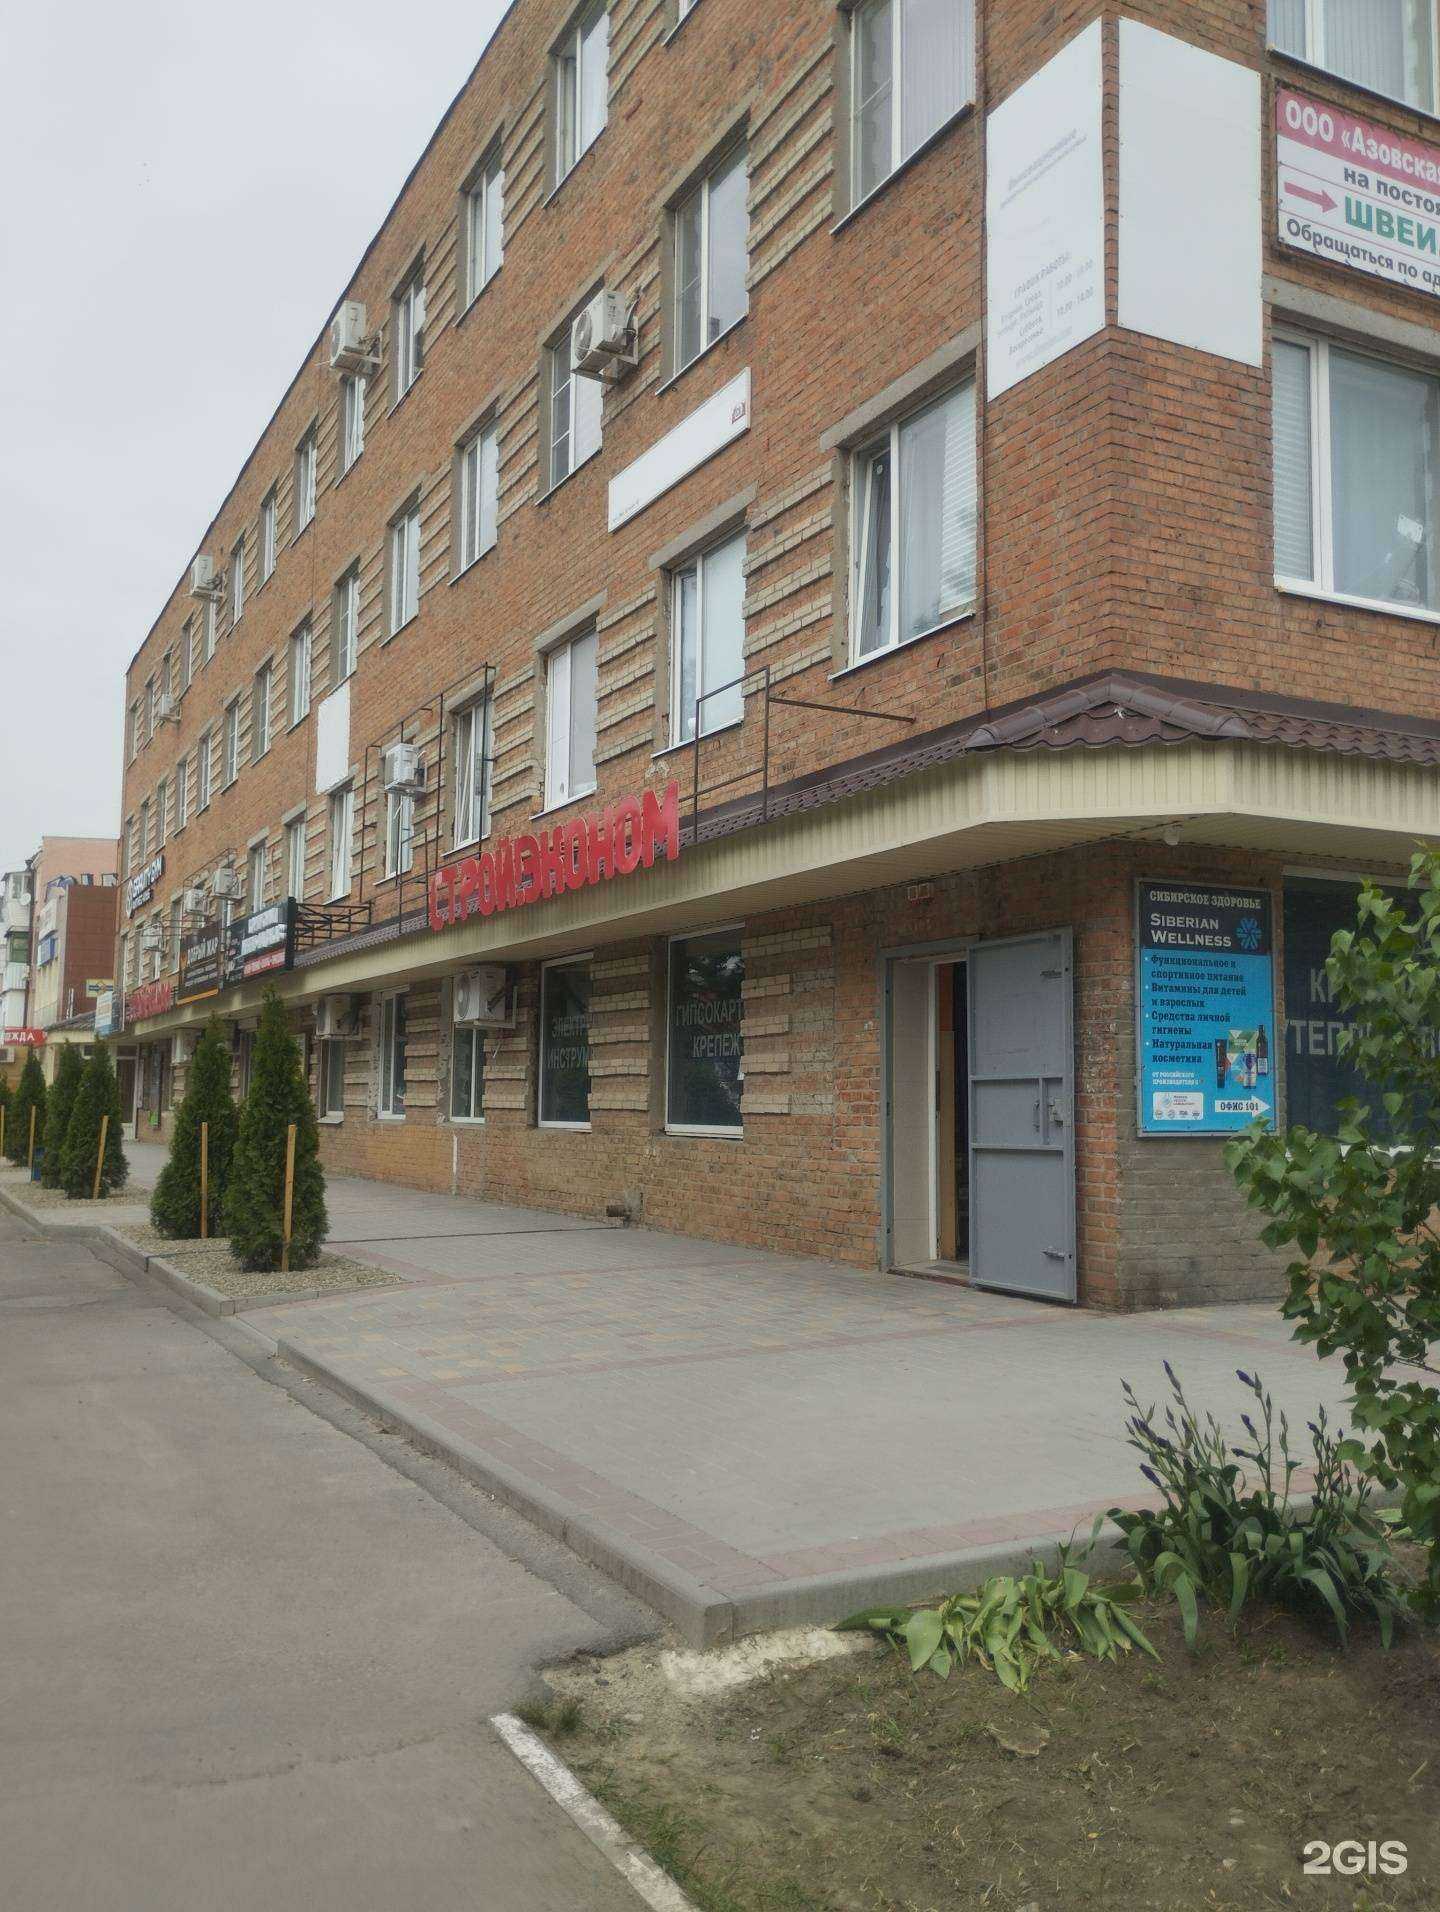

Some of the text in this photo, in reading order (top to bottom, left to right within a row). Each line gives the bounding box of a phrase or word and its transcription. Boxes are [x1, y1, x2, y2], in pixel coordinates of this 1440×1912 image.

[1285, 100, 1334, 142] ООО
[1343, 167, 1369, 190] на
[1287, 218, 1394, 271] Обращаться
[1398, 262, 1418, 279] по
[1150, 890, 1261, 909] СИБИРСКОЕ ЗДОРОВЬЕ
[1151, 983, 1247, 996] Витамины для детей
[1151, 999, 1205, 1010] и взрослых
[1151, 1010, 1231, 1023] Средства личной
[1151, 1026, 1192, 1035] гигиены
[1151, 1039, 1213, 1051] Натуральная
[1152, 1054, 1202, 1064] косметика
[1220, 1102, 1259, 1111] ОФИС 101
